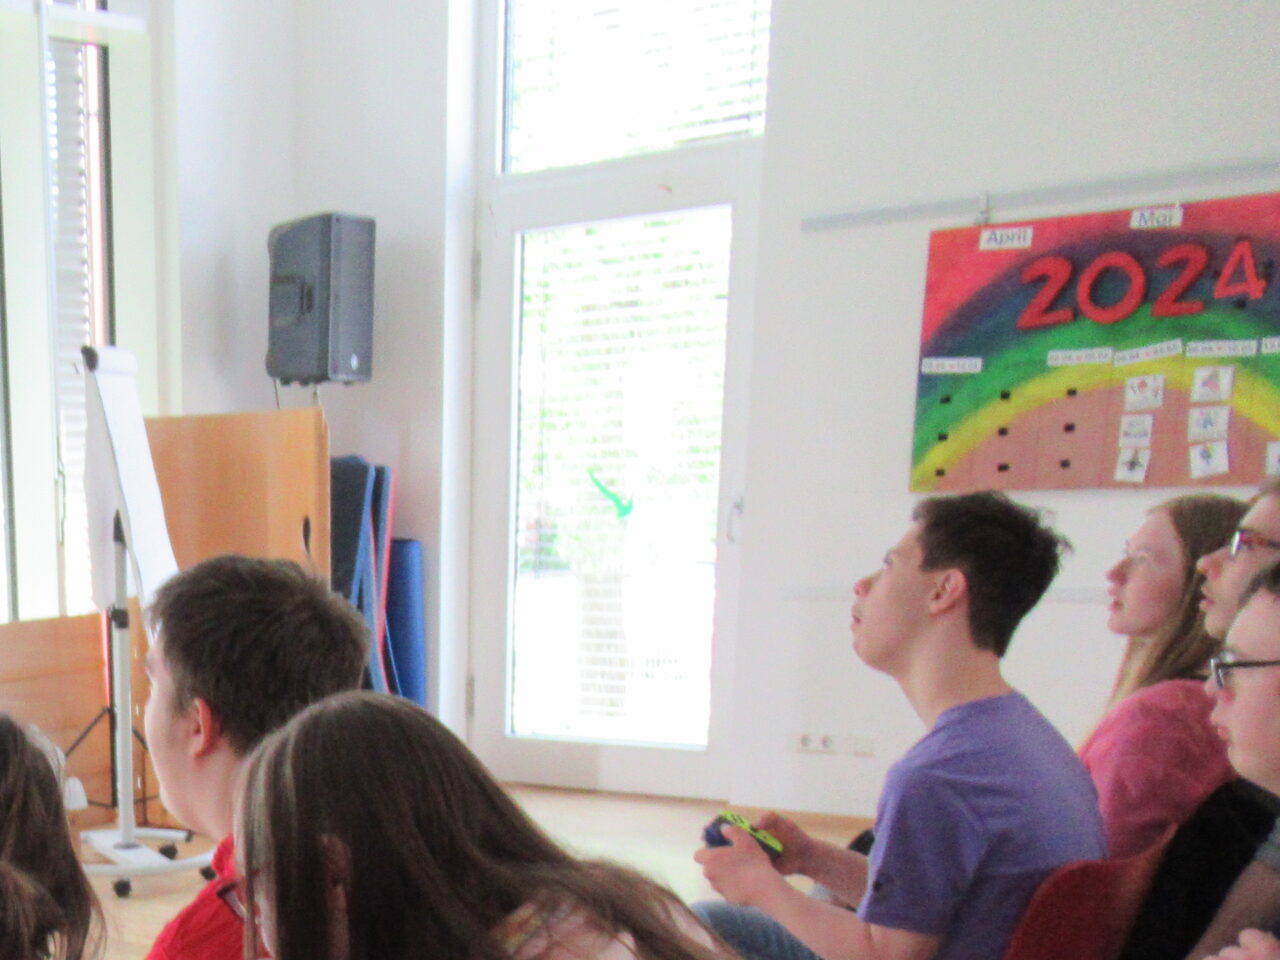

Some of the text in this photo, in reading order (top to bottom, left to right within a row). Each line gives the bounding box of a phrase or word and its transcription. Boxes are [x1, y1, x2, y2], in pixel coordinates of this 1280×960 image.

[1136, 211, 1174, 227] Mai
[985, 229, 1029, 248] April
[1017, 240, 1267, 330] 2024
